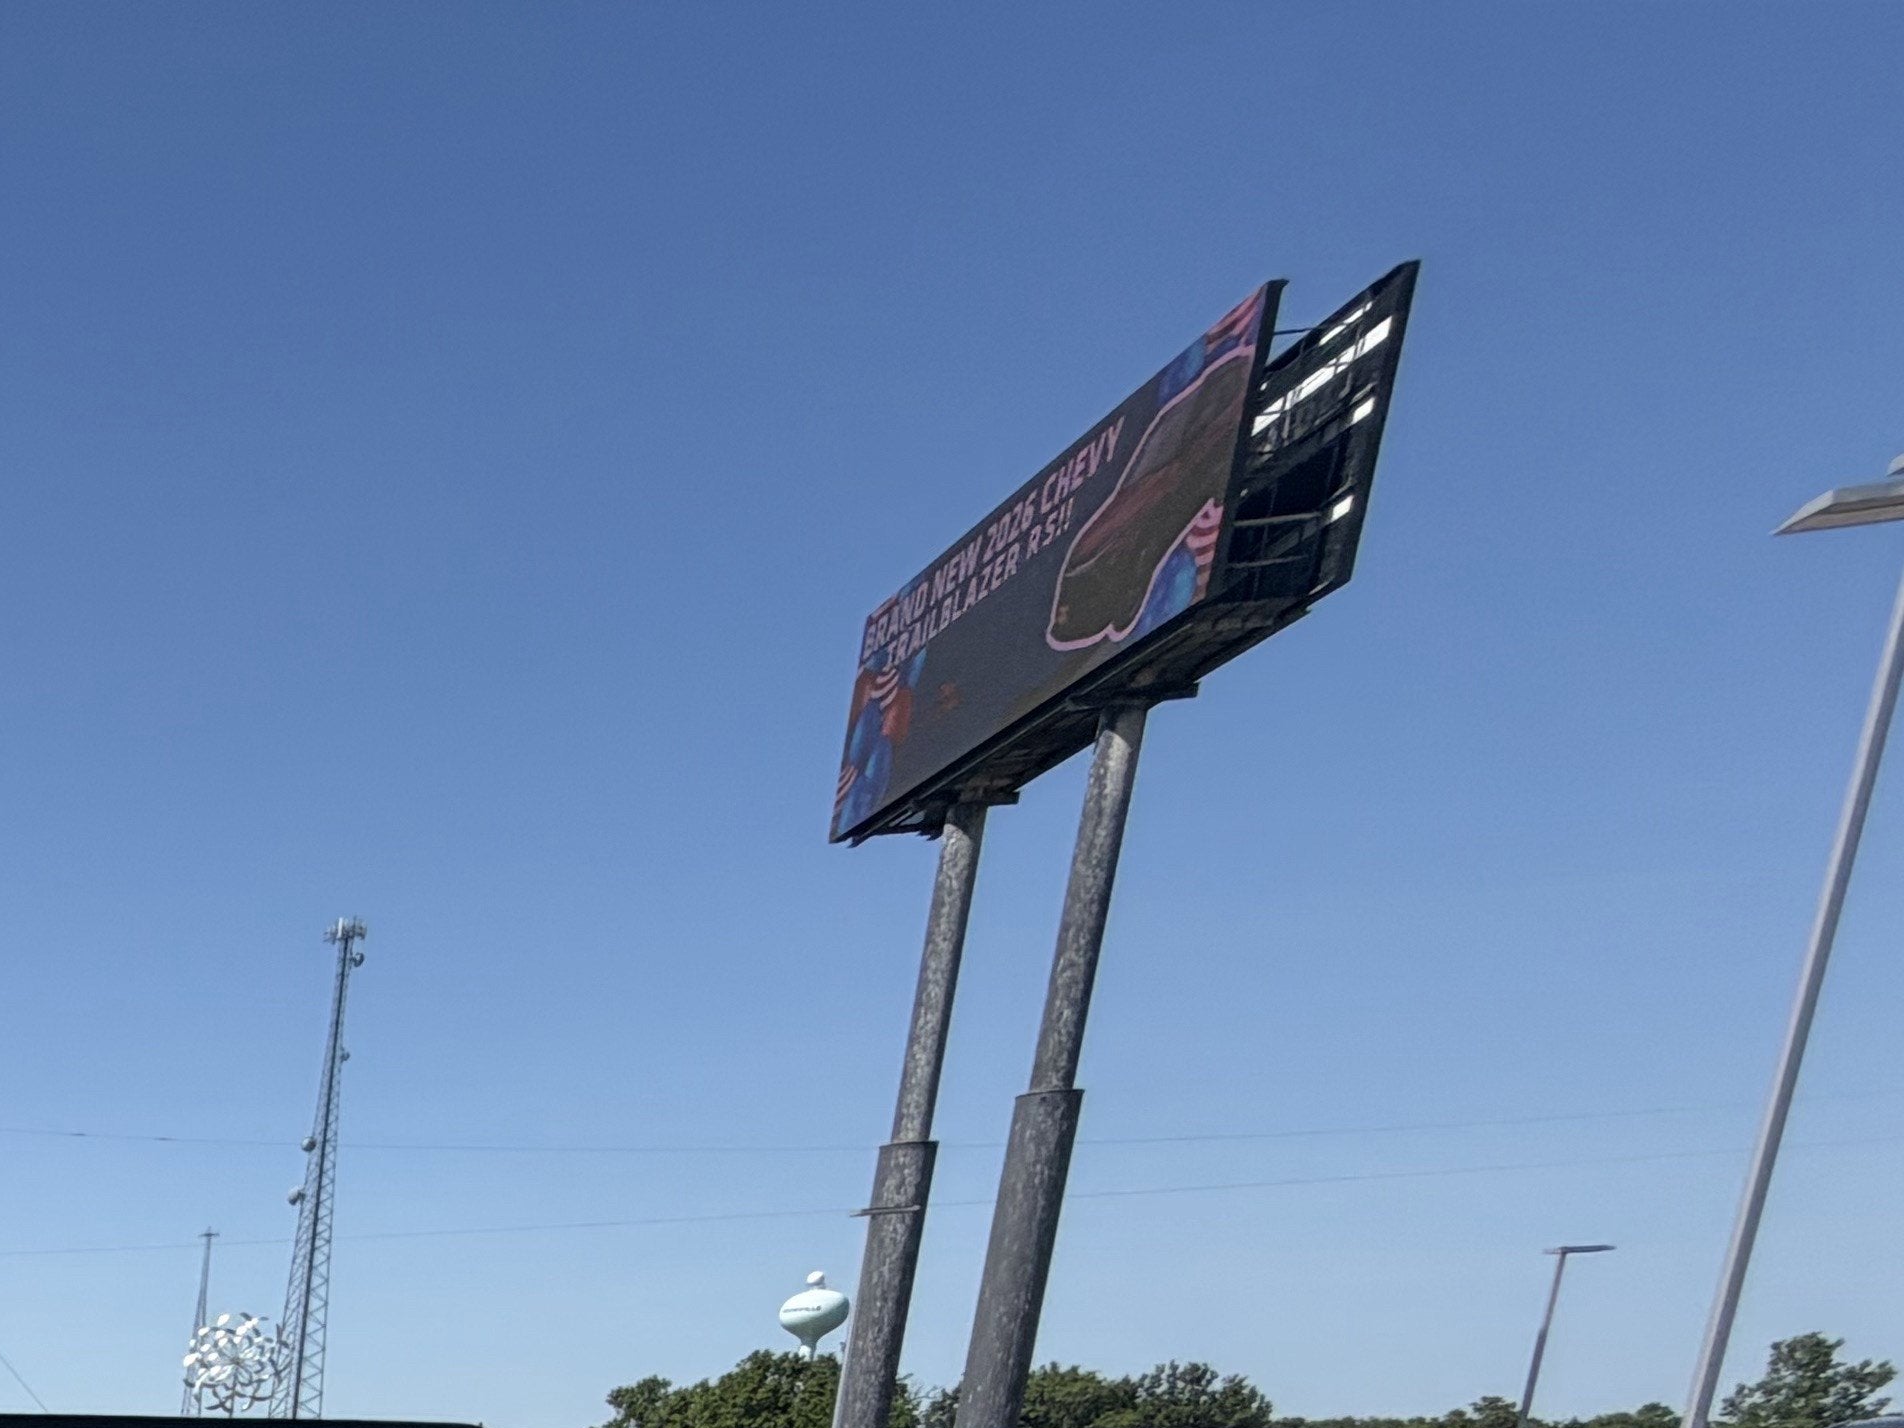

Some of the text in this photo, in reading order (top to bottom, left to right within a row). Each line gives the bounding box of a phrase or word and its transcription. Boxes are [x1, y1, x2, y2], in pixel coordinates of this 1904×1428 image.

[862, 415, 1125, 660] BRAND NEW 2026 CHEVY
[882, 498, 1074, 673] TRAILBLAZER RS!!
